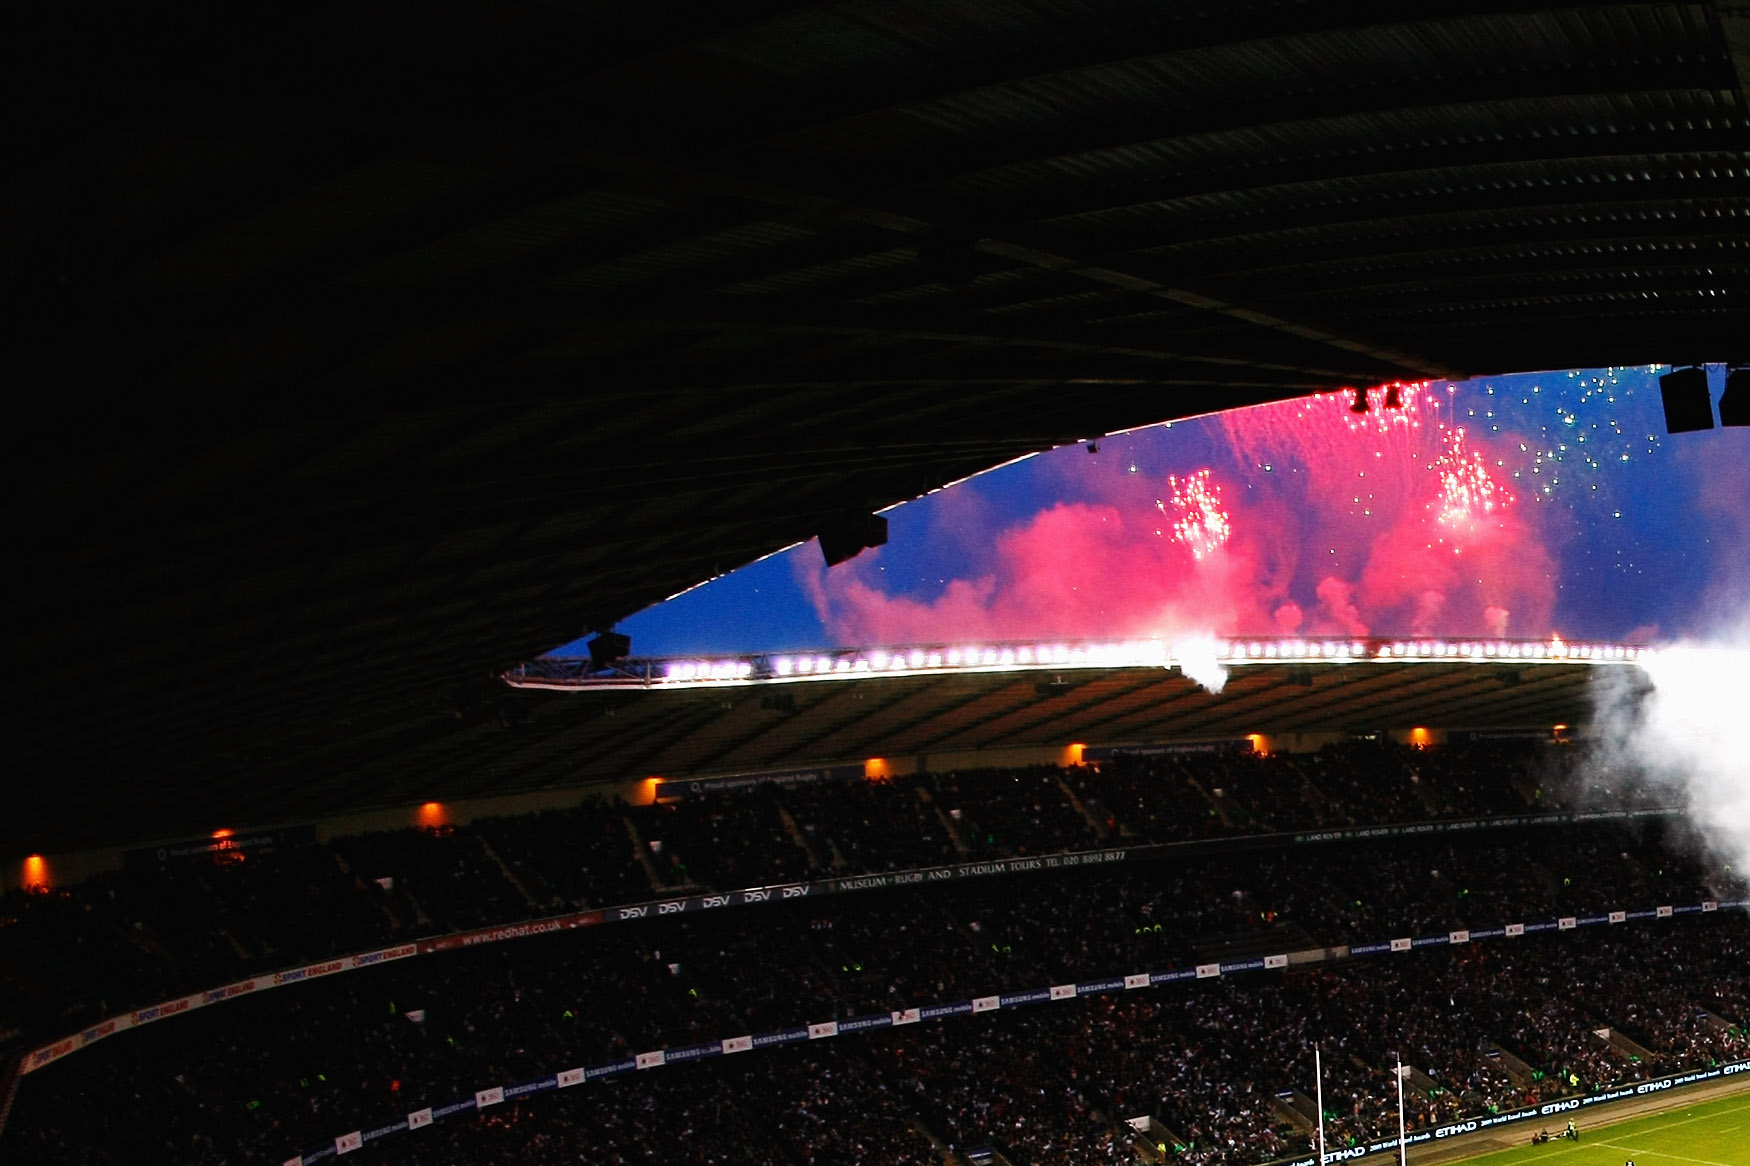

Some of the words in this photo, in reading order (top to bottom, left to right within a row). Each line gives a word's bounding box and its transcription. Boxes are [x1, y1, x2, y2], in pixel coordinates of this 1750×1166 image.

[840, 878, 886, 890] MUSEUM
[895, 873, 923, 884] RUGBY
[928, 870, 951, 880] AND
[959, 864, 1005, 876] STADIUM
[1010, 861, 1041, 870] TOURS
[1046, 859, 1059, 867] TEL
[1063, 856, 1079, 864] 020
[744, 891, 771, 903] DSV
[782, 886, 809, 898] DSV
[659, 902, 686, 914] DSV
[703, 895, 730, 908] DSV
[620, 907, 647, 919] DSV
[463, 921, 561, 945] www.redhat.co.uk
[360, 953, 382, 965] SPORT
[383, 947, 415, 959] ENGLAND
[283, 970, 307, 982] SPORT
[308, 962, 342, 976] ENGLAND
[1637, 1079, 1672, 1094] ETIHAD
[1541, 1100, 1579, 1114] ETIHAD
[1436, 1122, 1477, 1138] ETIHAD
